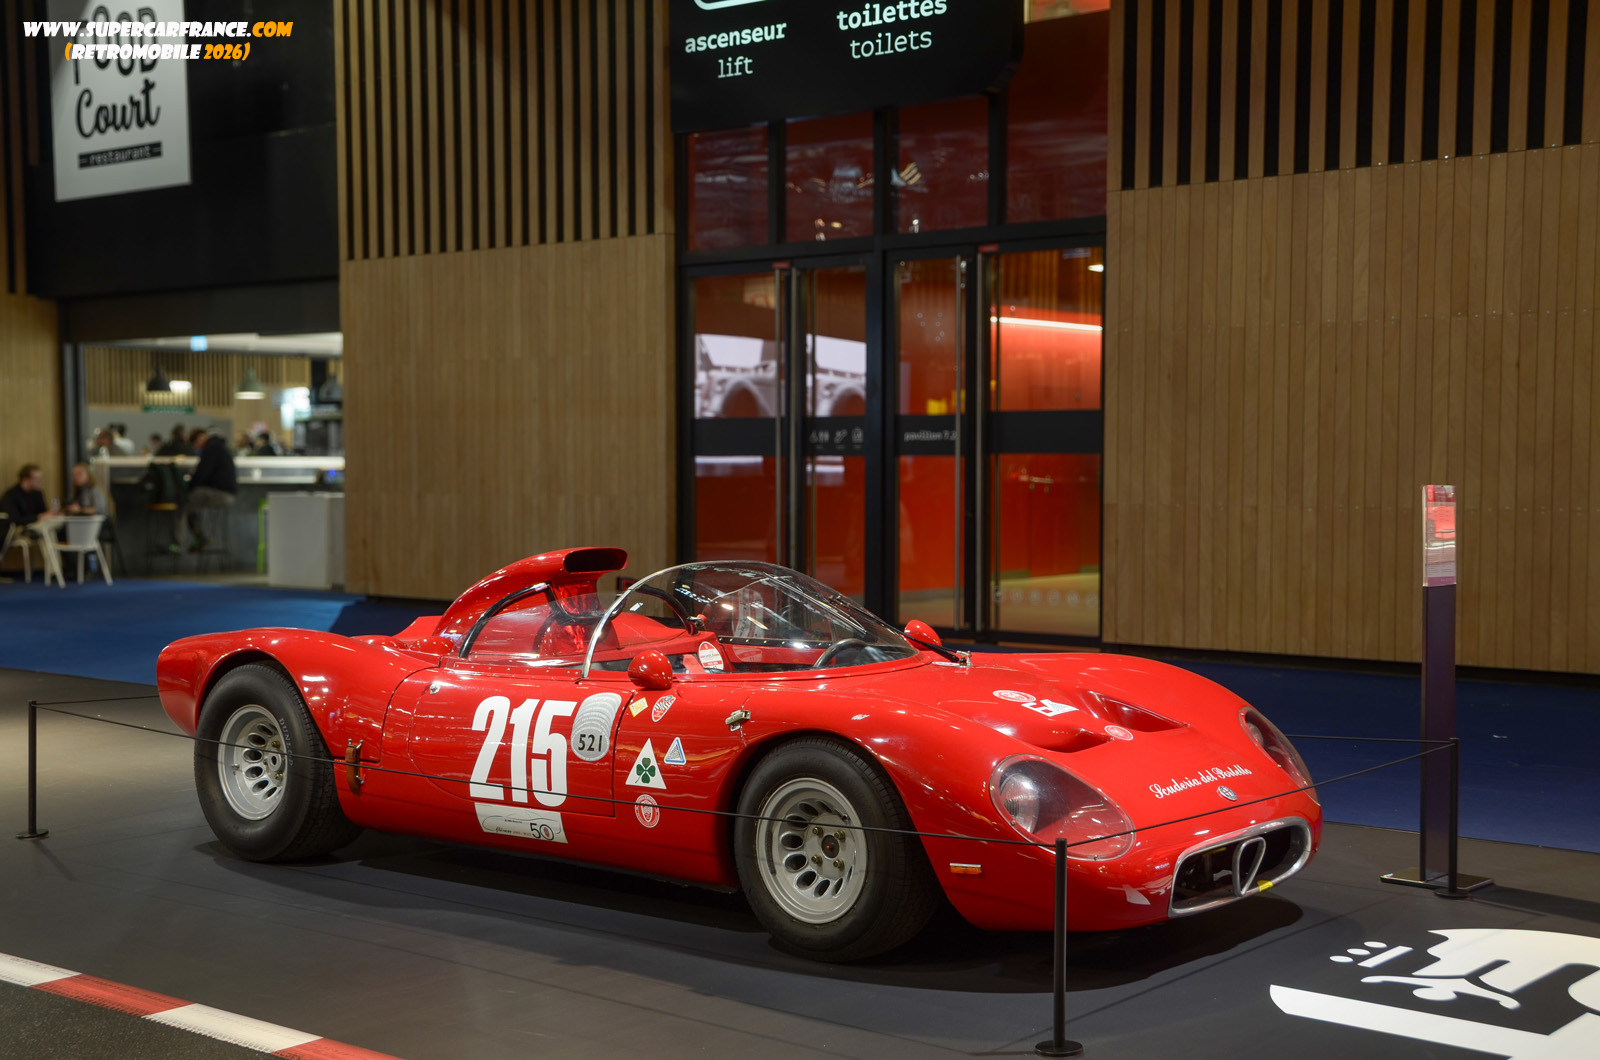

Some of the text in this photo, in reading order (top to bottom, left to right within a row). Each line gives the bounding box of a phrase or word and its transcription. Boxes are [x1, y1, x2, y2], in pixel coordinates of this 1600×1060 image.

[836, 0, 948, 31] toilettes
[685, 22, 787, 53] ascenseur
[849, 30, 932, 59] toilets
[717, 55, 753, 78] lift
[75, 78, 161, 139] Court
[88, 145, 152, 165] restaurant
[469, 695, 578, 807] 215
[578, 733, 603, 752] 521
[1148, 778, 1202, 799] Scuderia
[1197, 769, 1219, 784] del
[530, 822, 554, 841] 50
